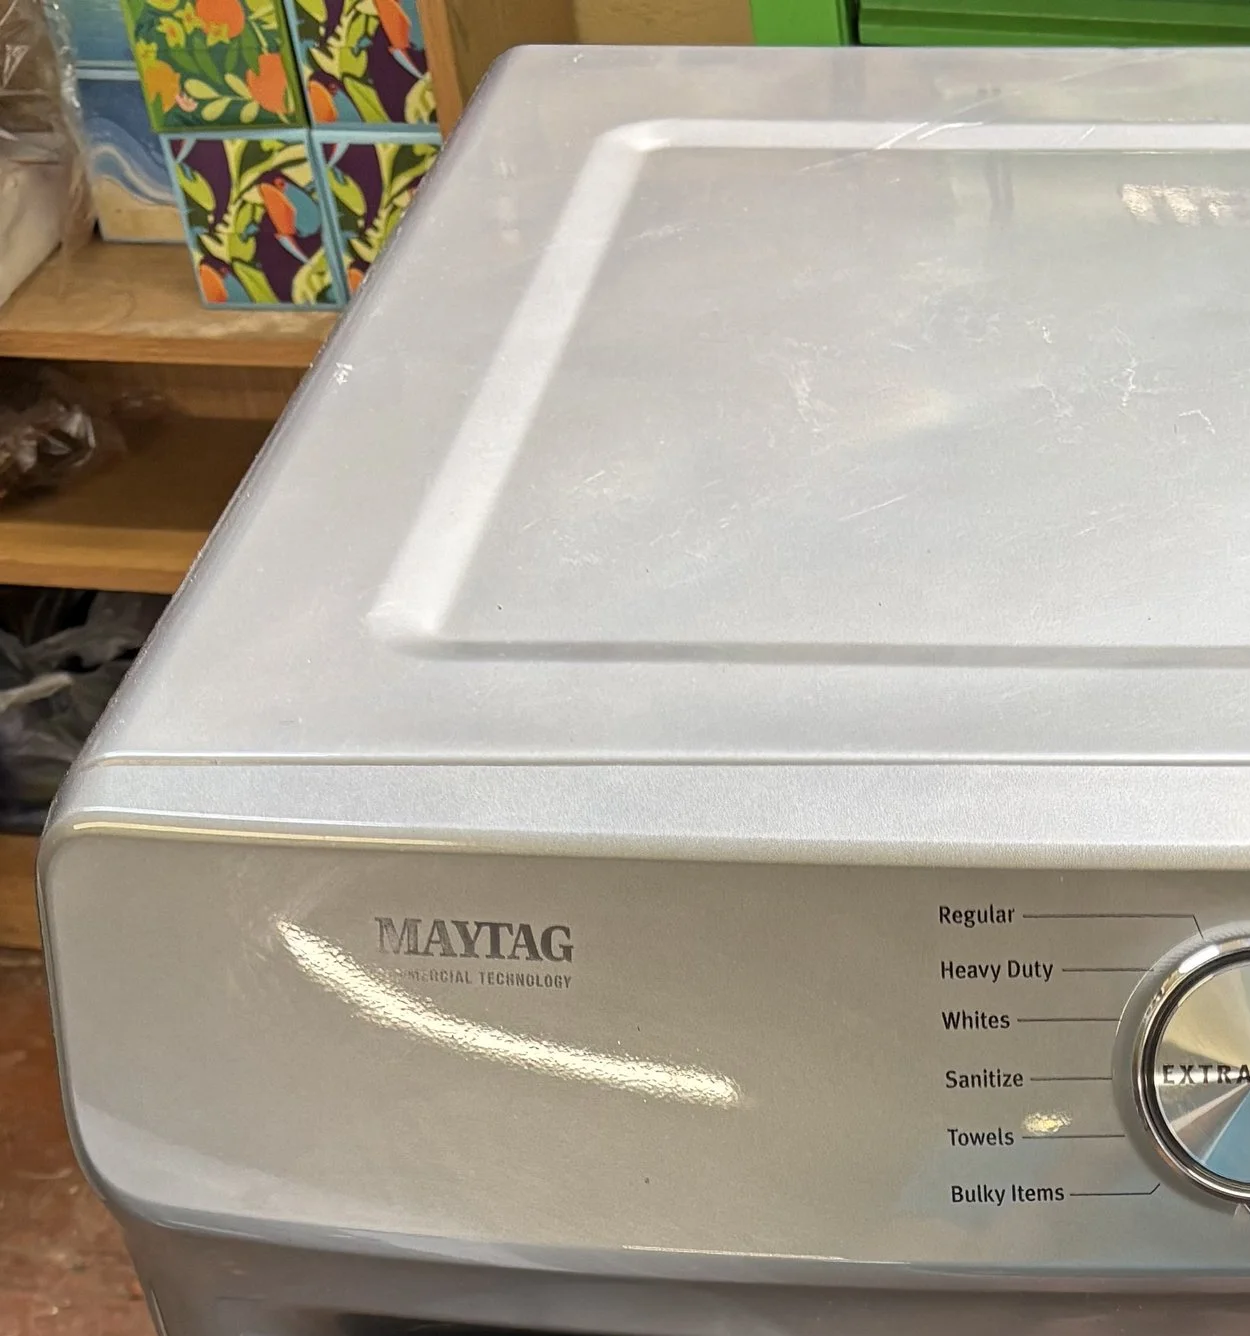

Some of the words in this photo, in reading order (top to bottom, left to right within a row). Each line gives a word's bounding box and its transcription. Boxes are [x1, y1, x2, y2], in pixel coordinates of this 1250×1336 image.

[938, 904, 1015, 928] Regular
[374, 917, 574, 963] MAYTAG
[479, 971, 572, 988] TECHNOLOGY
[941, 960, 1001, 983] Heavy
[1007, 959, 1054, 982] Duty
[941, 1010, 1010, 1029] Whites
[945, 1069, 1024, 1088] Sanitize
[947, 1128, 1014, 1146] Towels
[951, 1185, 1005, 1206] Bulky
[1011, 1184, 1064, 1202] Items
